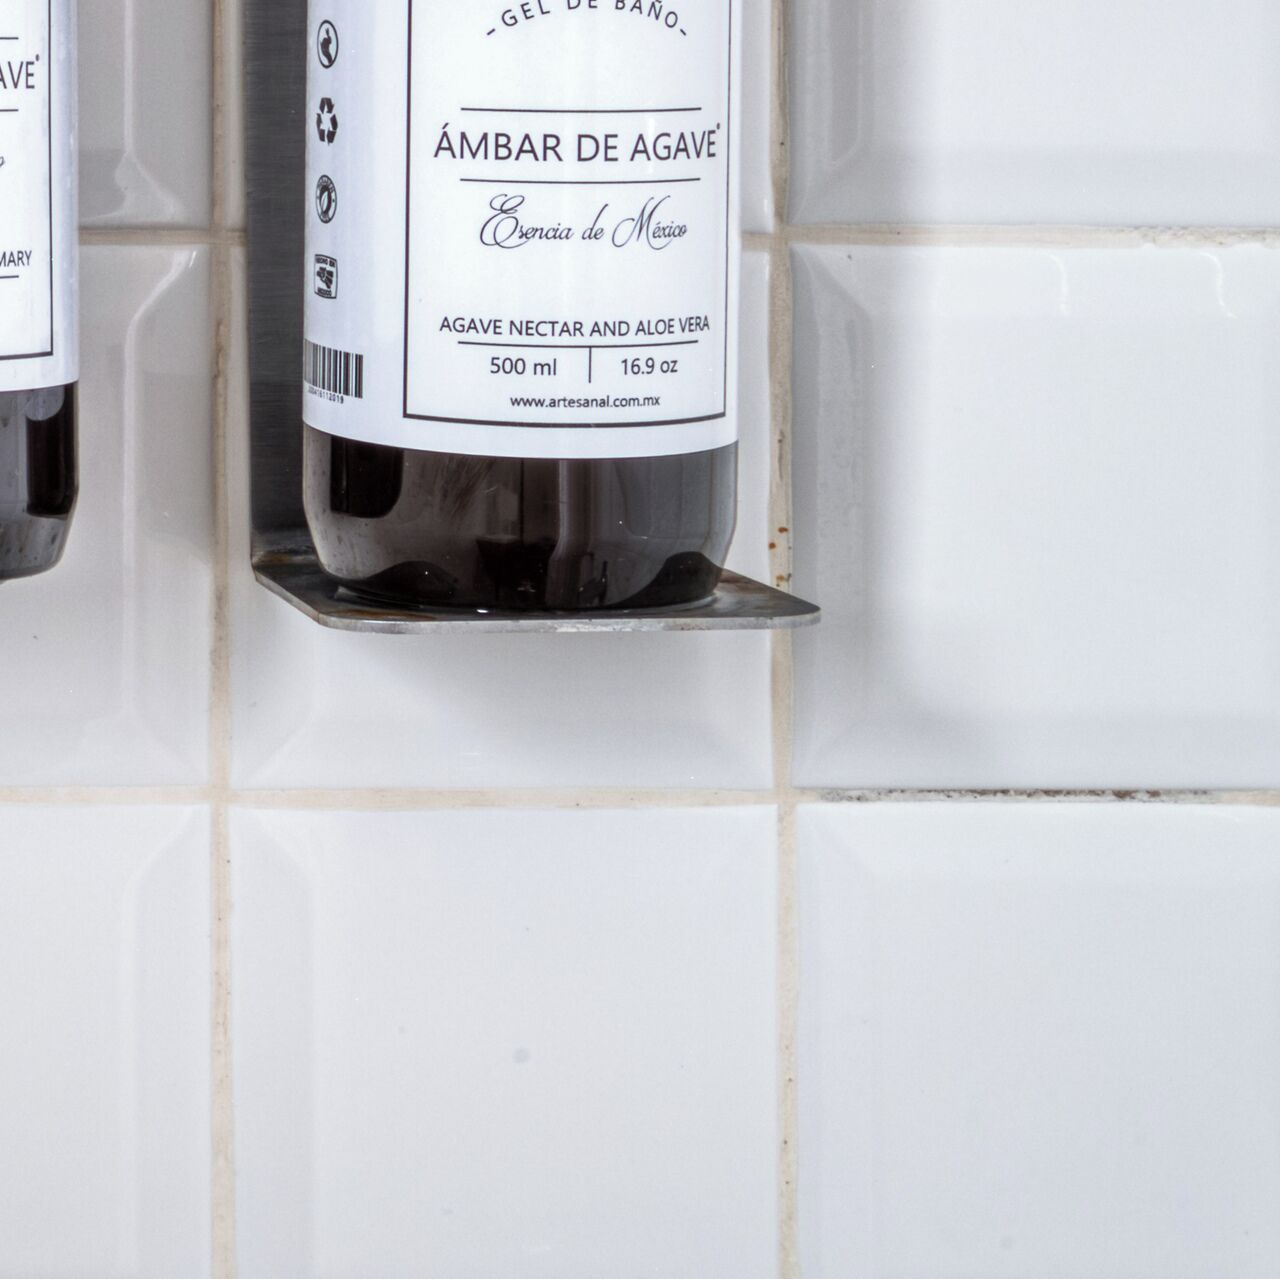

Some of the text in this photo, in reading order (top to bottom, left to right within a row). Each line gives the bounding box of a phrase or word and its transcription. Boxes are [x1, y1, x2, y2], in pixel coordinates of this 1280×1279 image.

[432, 121, 564, 163] ÁMBAR
[576, 133, 619, 163] DE
[479, 193, 688, 251] Esencia de México
[438, 314, 711, 338] AGAVE NECTAR AND ALOE VERA
[489, 356, 558, 377] 500 ml
[620, 356, 679, 376] 16.9 oz
[509, 394, 661, 409] www.artesanal.com.mx
